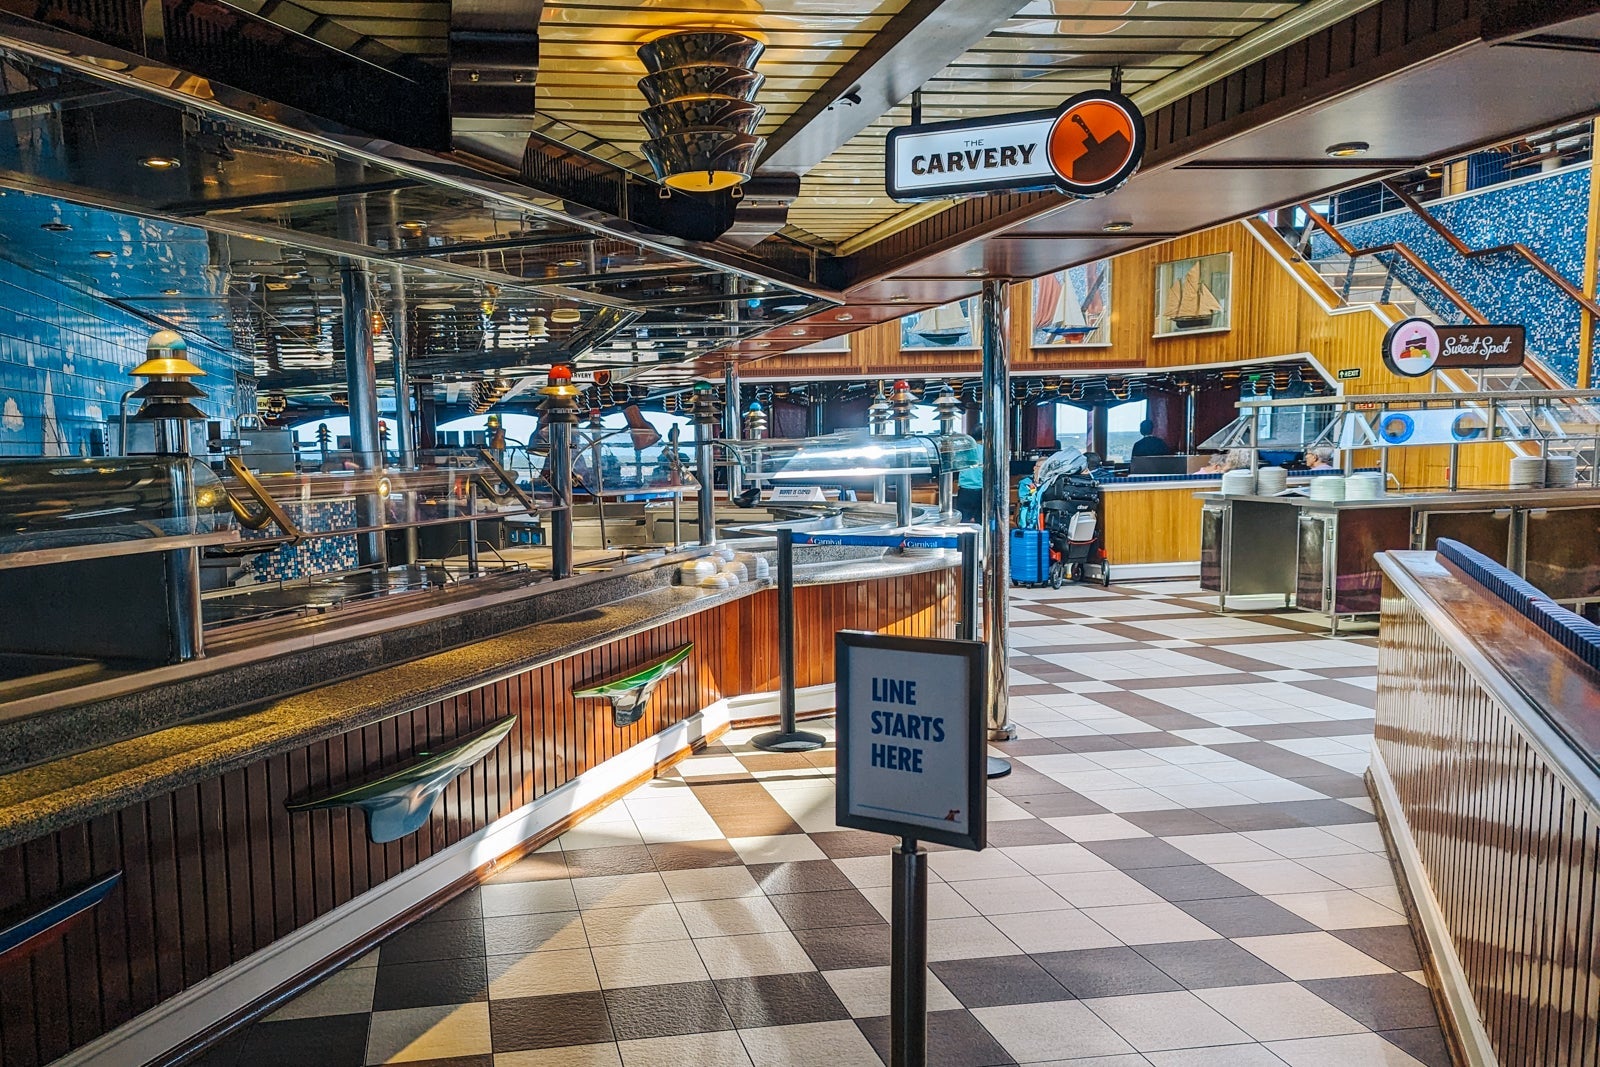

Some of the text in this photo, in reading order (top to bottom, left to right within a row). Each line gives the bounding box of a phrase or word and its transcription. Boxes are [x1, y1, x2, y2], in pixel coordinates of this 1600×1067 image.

[964, 139, 984, 147] THE
[911, 143, 1036, 175] CARVERY
[1442, 336, 1512, 360] Sweet Spot
[1459, 334, 1469, 343] The
[813, 537, 842, 545] Carnival
[872, 677, 916, 705] LINE
[871, 710, 945, 743] STARTS
[871, 743, 923, 773] HERE
